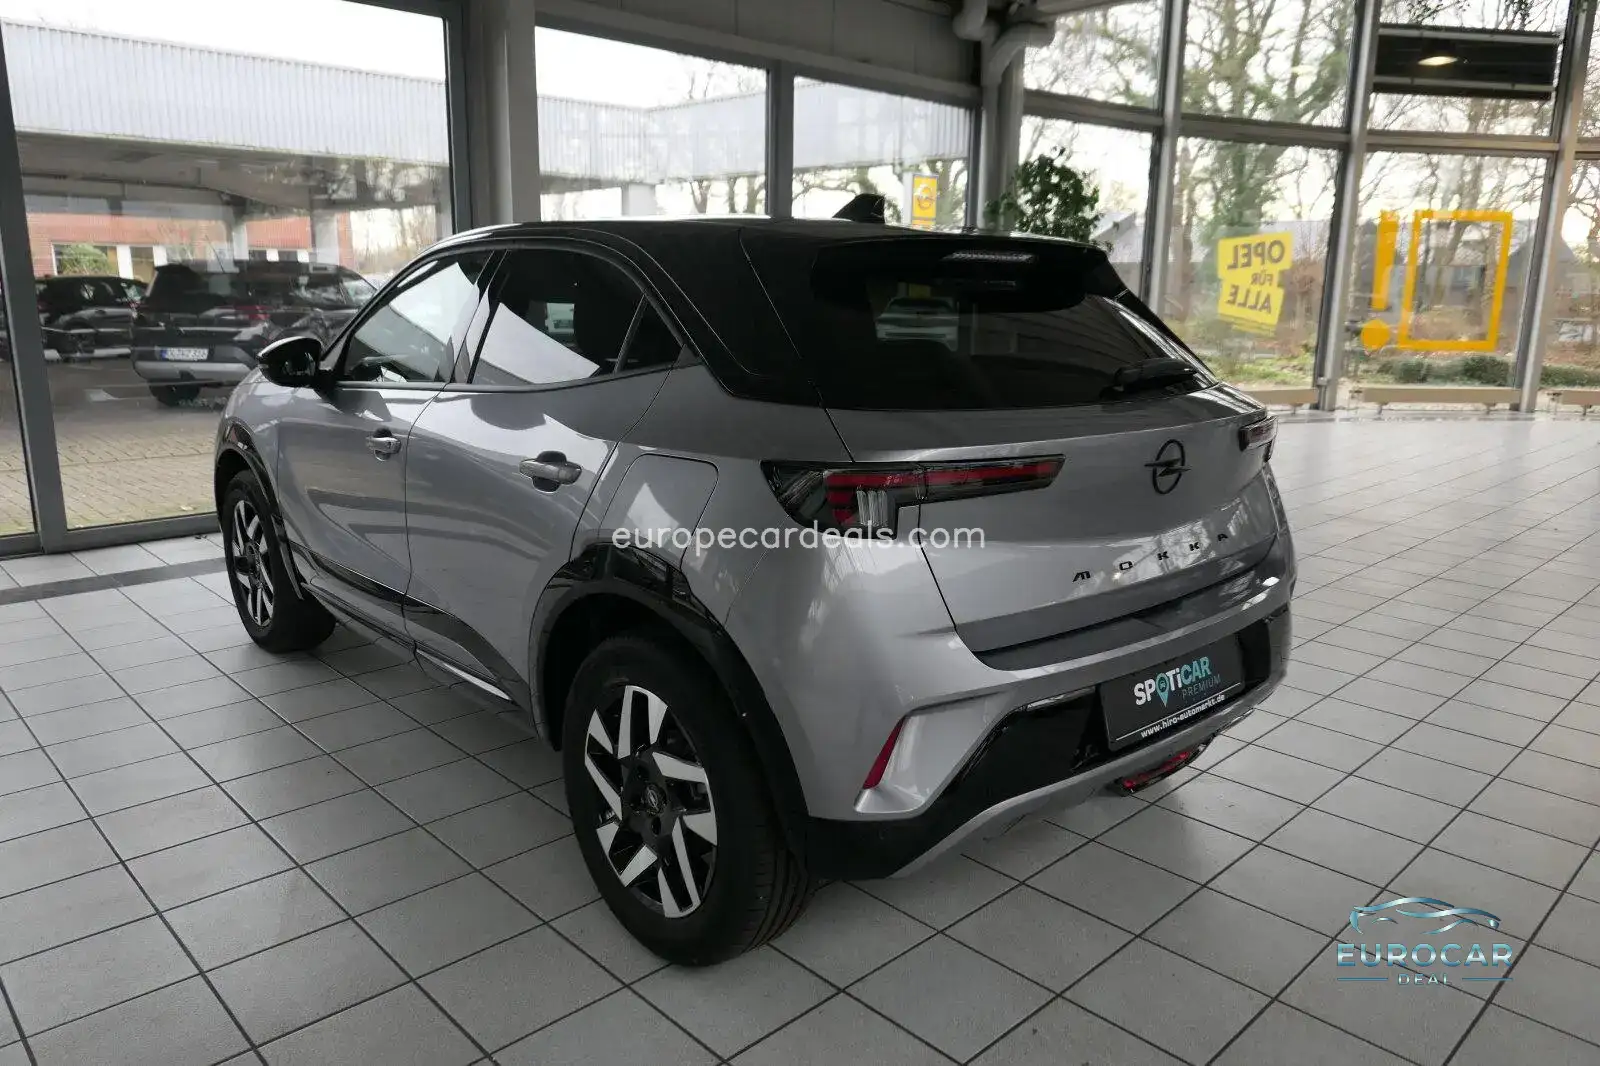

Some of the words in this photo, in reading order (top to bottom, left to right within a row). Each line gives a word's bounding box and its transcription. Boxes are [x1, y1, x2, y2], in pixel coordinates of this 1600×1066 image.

[1072, 533, 1228, 583] MOKKA
[1181, 674, 1221, 701] PREMIUM
[1140, 694, 1225, 738] www.hiro-automarkt.de
